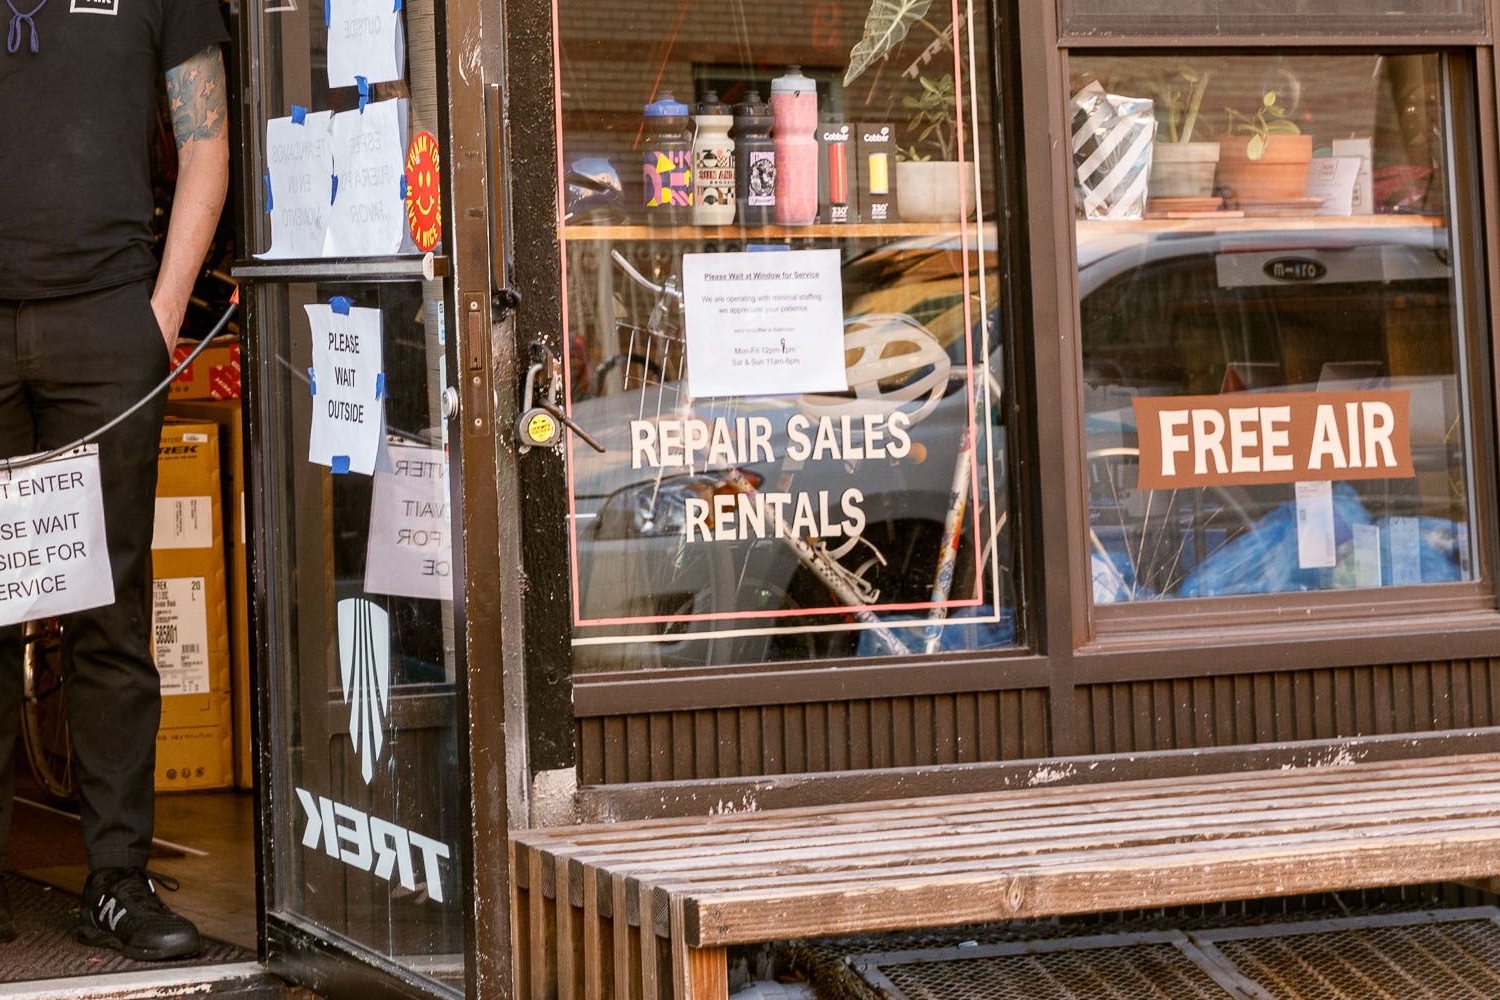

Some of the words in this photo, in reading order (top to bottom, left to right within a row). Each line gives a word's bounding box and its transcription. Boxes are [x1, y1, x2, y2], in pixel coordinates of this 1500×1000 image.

[823, 131, 849, 141] Cobber
[863, 132, 889, 142] Cobber
[407, 135, 428, 173] THANK
[406, 184, 418, 231] HAVE
[415, 226, 421, 243] A
[422, 223, 439, 248] NICE
[704, 272, 727, 281] Please
[729, 272, 744, 280] Wait
[754, 271, 781, 280] Window
[782, 271, 792, 280] for
[794, 271, 820, 280] Service
[328, 332, 360, 354] PLEASE
[334, 366, 356, 388] WAIT
[328, 399, 364, 424] OUTSIDE
[630, 416, 776, 469] REPAIR
[786, 411, 912, 462] SALES
[1158, 405, 1294, 477] FREE
[1306, 401, 1398, 470] AIR
[18, 471, 85, 498] ENTER
[32, 512, 80, 536] WAIT
[685, 487, 867, 544] RENTALS
[46, 541, 87, 564] FOR
[191, 581, 201, 590] 20
